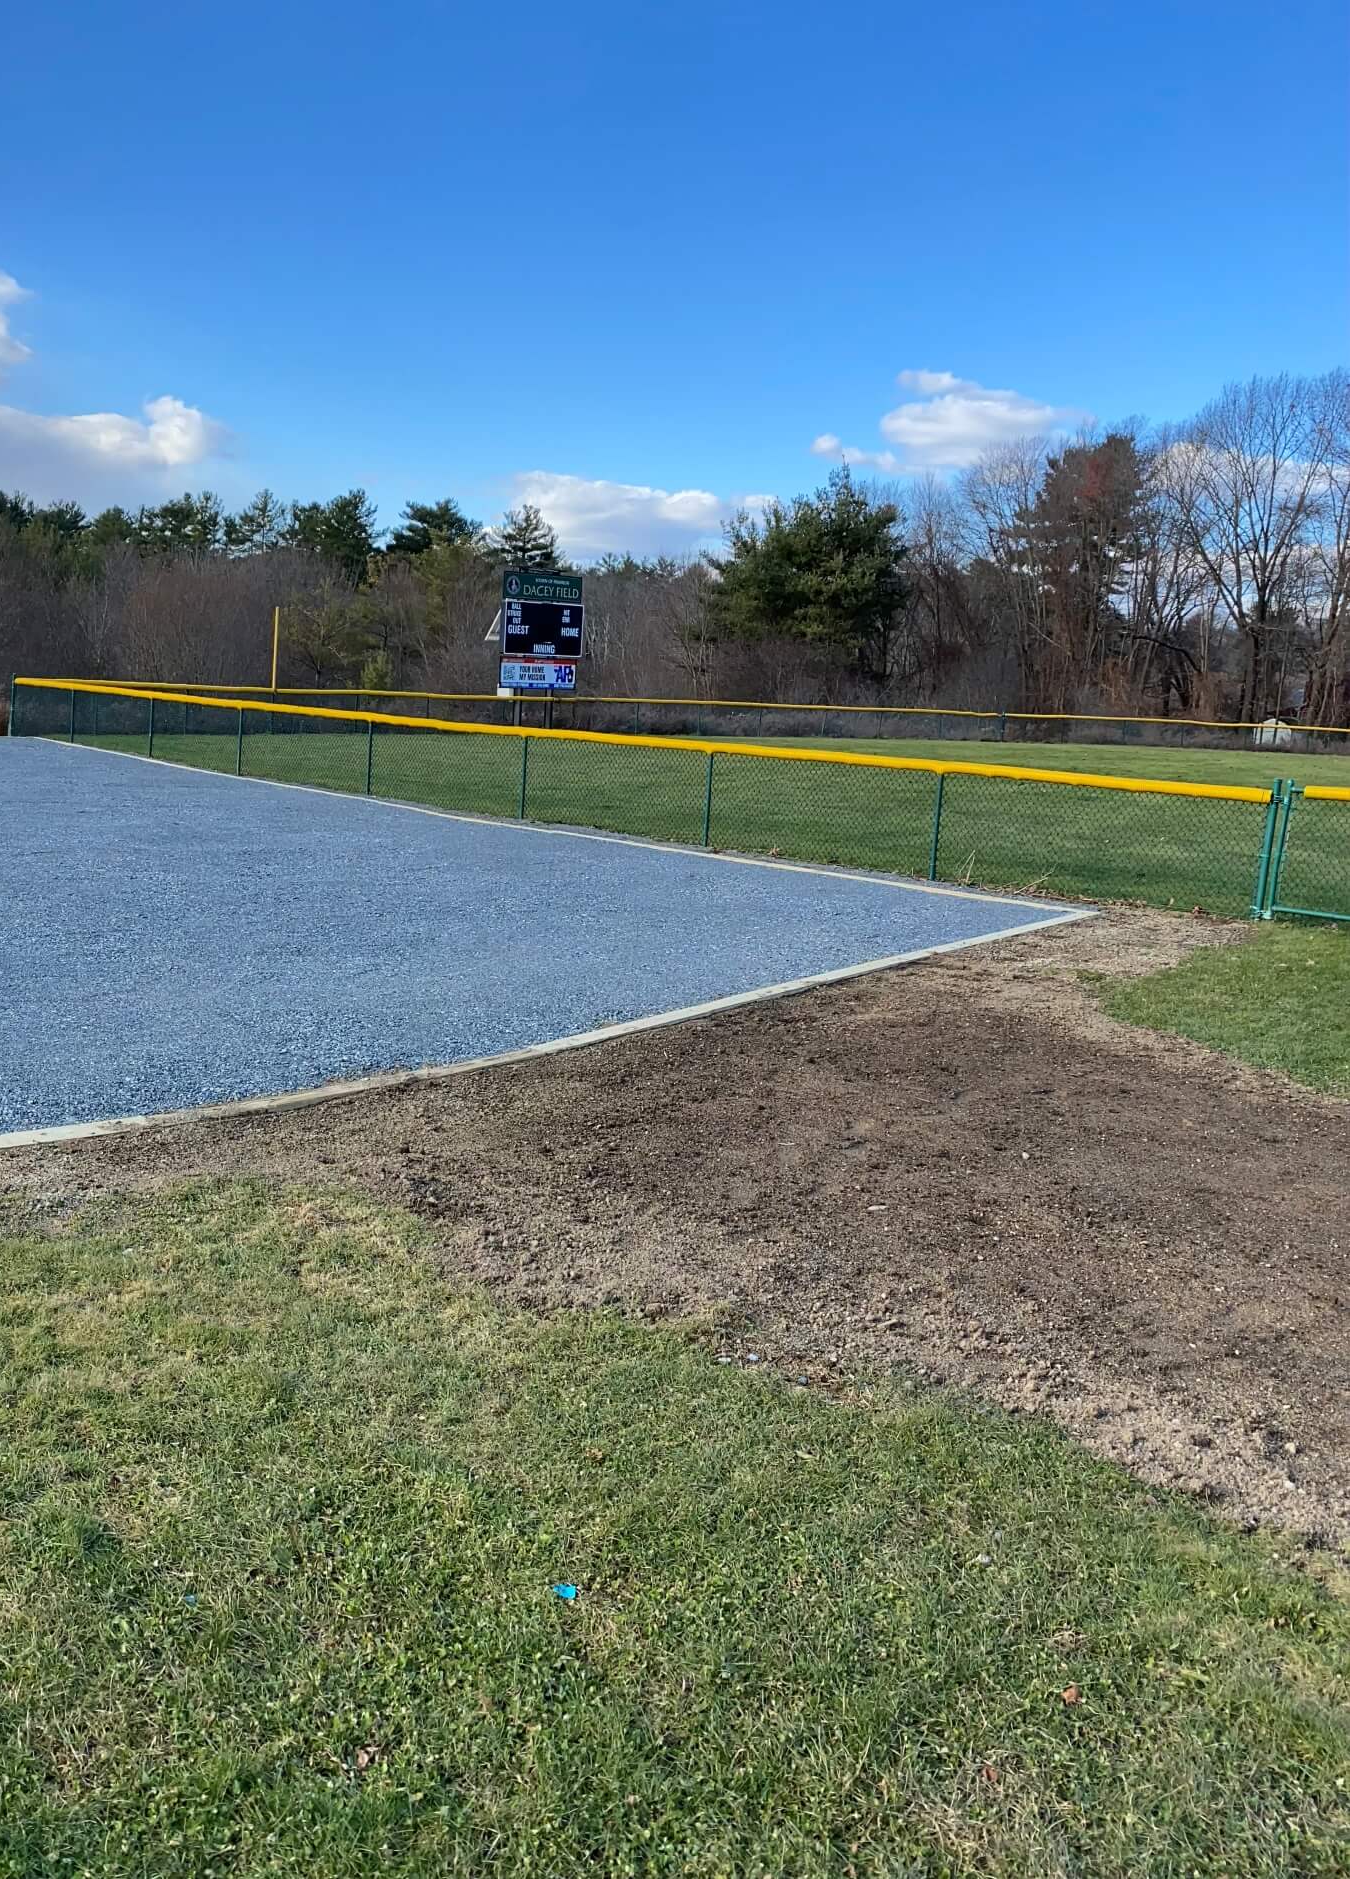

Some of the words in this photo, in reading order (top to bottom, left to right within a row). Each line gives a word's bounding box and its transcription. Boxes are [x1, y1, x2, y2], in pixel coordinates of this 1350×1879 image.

[523, 584, 554, 596] DACEY
[557, 587, 578, 598] FIELD
[508, 625, 530, 634] GUEST
[562, 628, 579, 637] HOME
[534, 644, 555, 654] INNING
